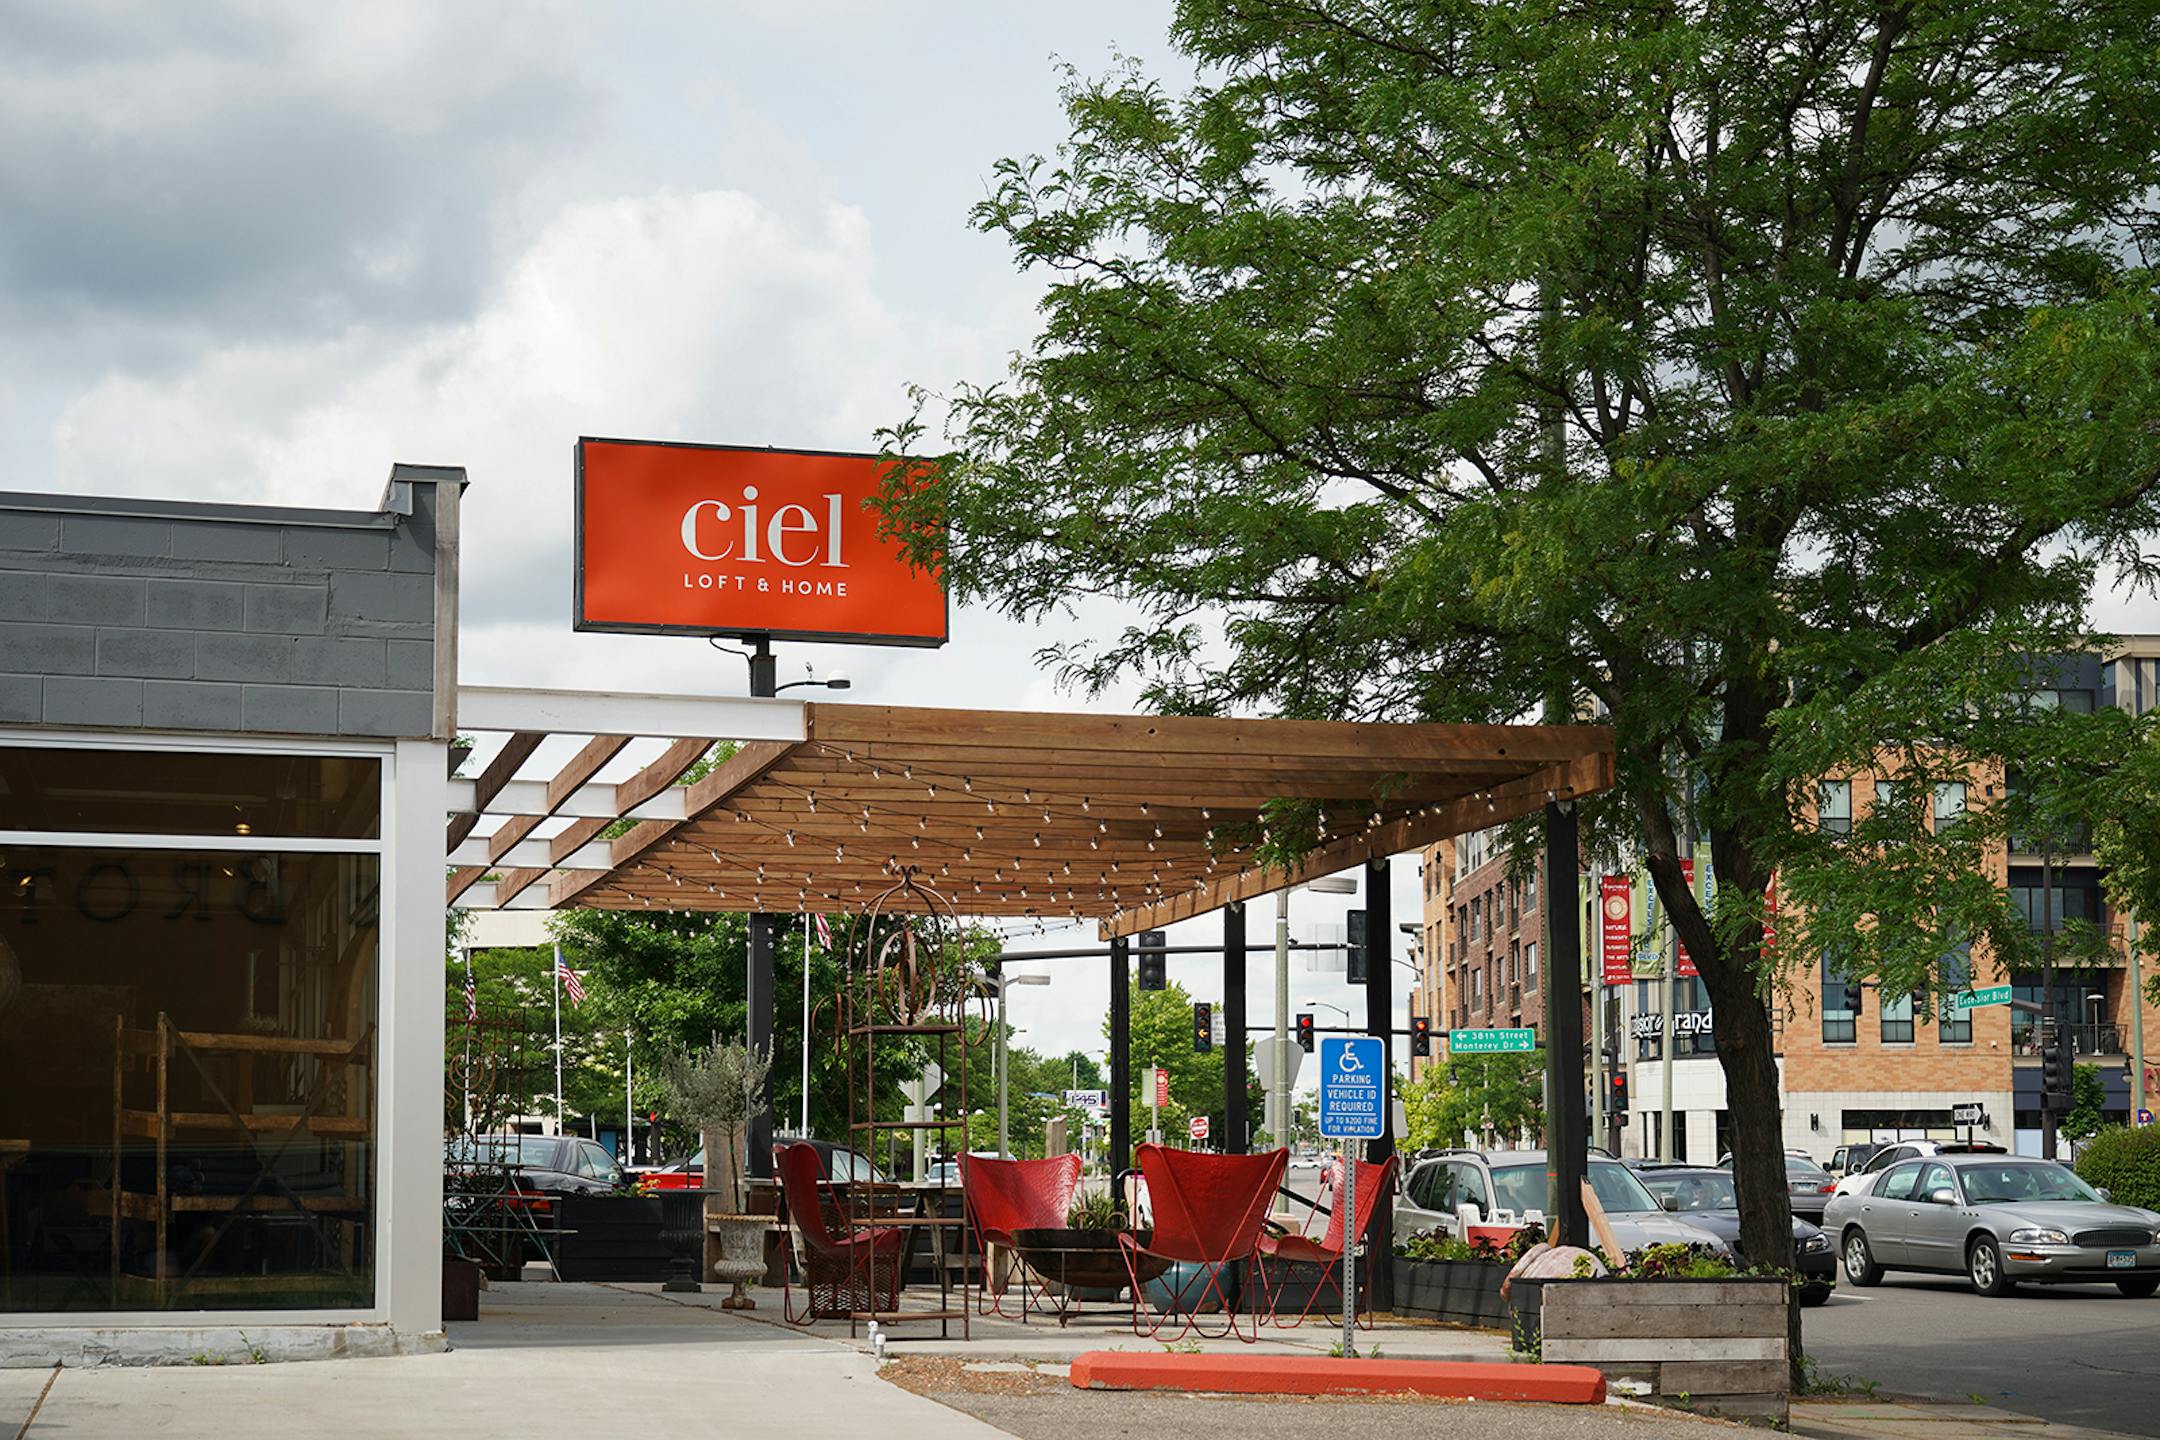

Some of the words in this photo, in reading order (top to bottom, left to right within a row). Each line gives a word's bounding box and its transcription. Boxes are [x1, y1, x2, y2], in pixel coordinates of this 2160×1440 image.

[680, 485, 850, 567] ciel
[683, 573, 746, 591] LOFT
[757, 576, 770, 593] &
[782, 578, 848, 597] HOME
[1992, 990, 2009, 1001] Blvd
[1673, 1008, 1713, 1036] rand
[1471, 1031, 1495, 1040] 38th
[1499, 1031, 1528, 1040] Street
[1455, 1042, 1498, 1050] Monterey
[1503, 1041, 1514, 1049] Dr
[1331, 1074, 1371, 1084] PARKING
[1327, 1089, 1364, 1099] VEHICLE
[1367, 1089, 1376, 1099] ID
[1329, 1101, 1373, 1111] REQUIRED
[1325, 1117, 1333, 1125] UP
[1336, 1117, 1344, 1125] TO
[1345, 1117, 1362, 1125] $200
[1363, 1117, 1378, 1125] FINE
[1328, 1125, 1340, 1133] FOR
[1343, 1125, 1375, 1133] VIOLATION
